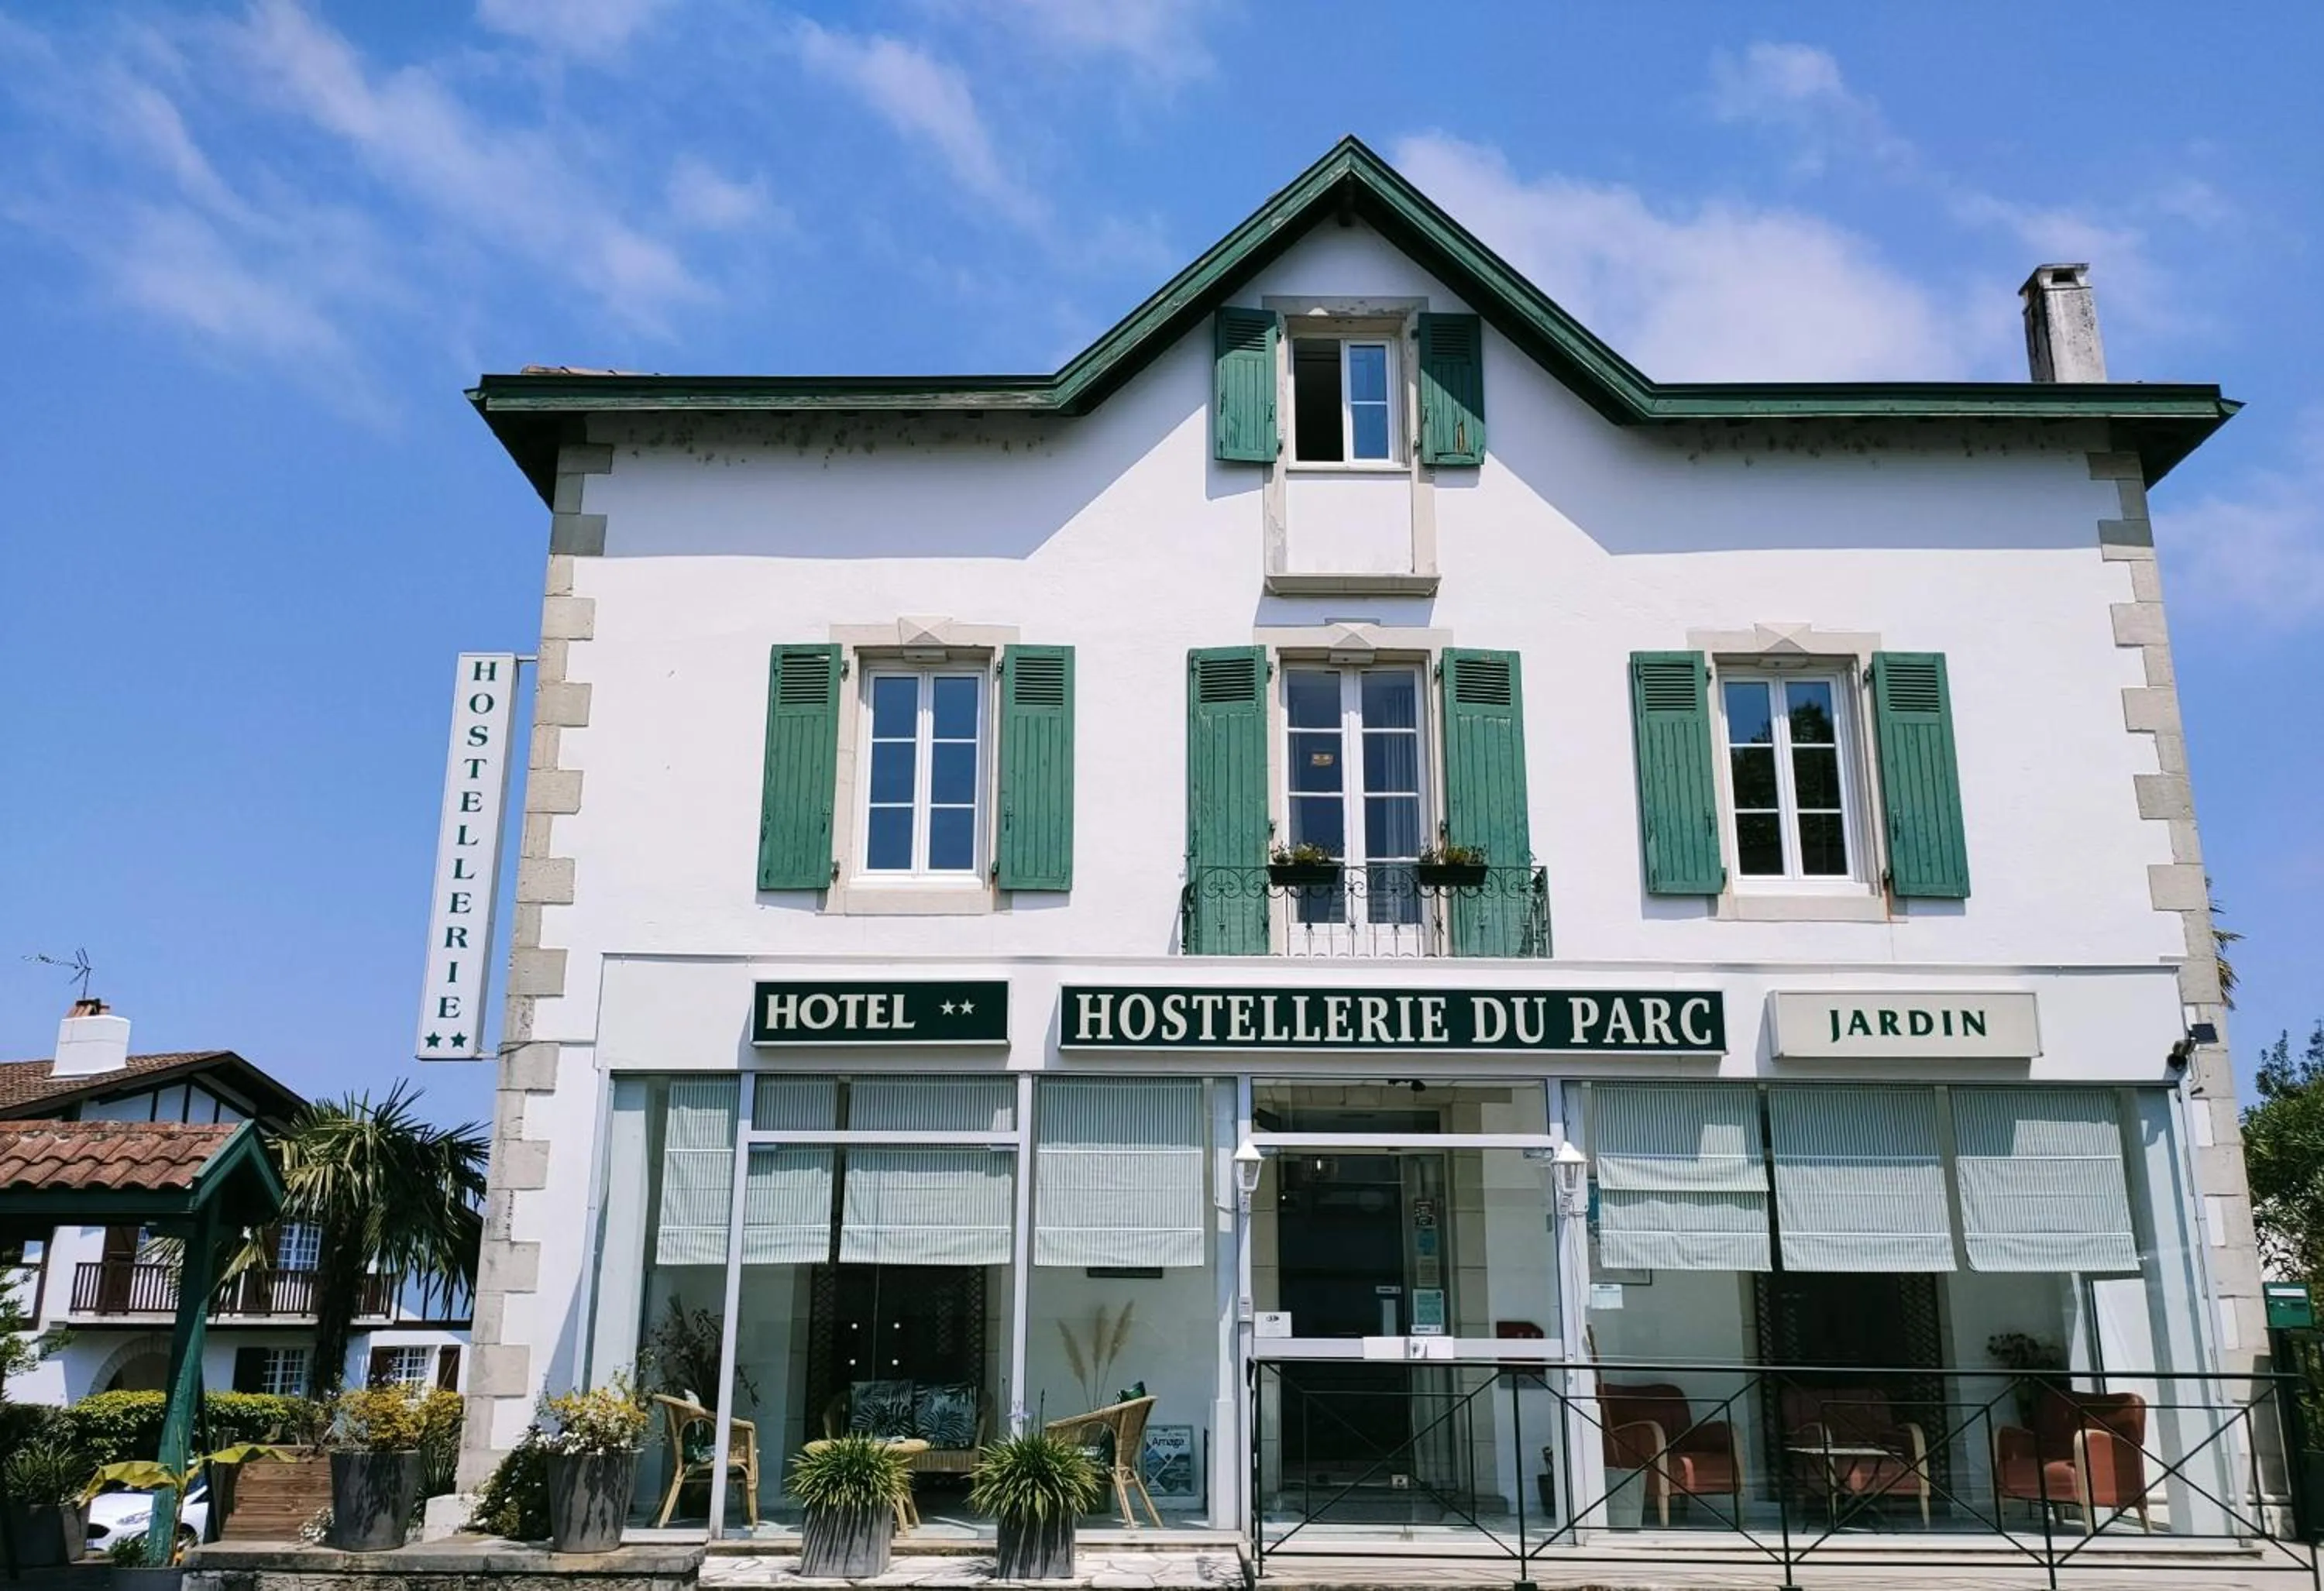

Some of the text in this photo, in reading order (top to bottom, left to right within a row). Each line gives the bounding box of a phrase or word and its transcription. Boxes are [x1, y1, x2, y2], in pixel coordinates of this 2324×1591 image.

[437, 660, 497, 1019] HOSTELLERIE
[765, 993, 916, 1029] HOTEL
[1075, 994, 1713, 1045] HOSTELLERIE DU PARC
[1829, 1009, 1987, 1043] JARDIN
